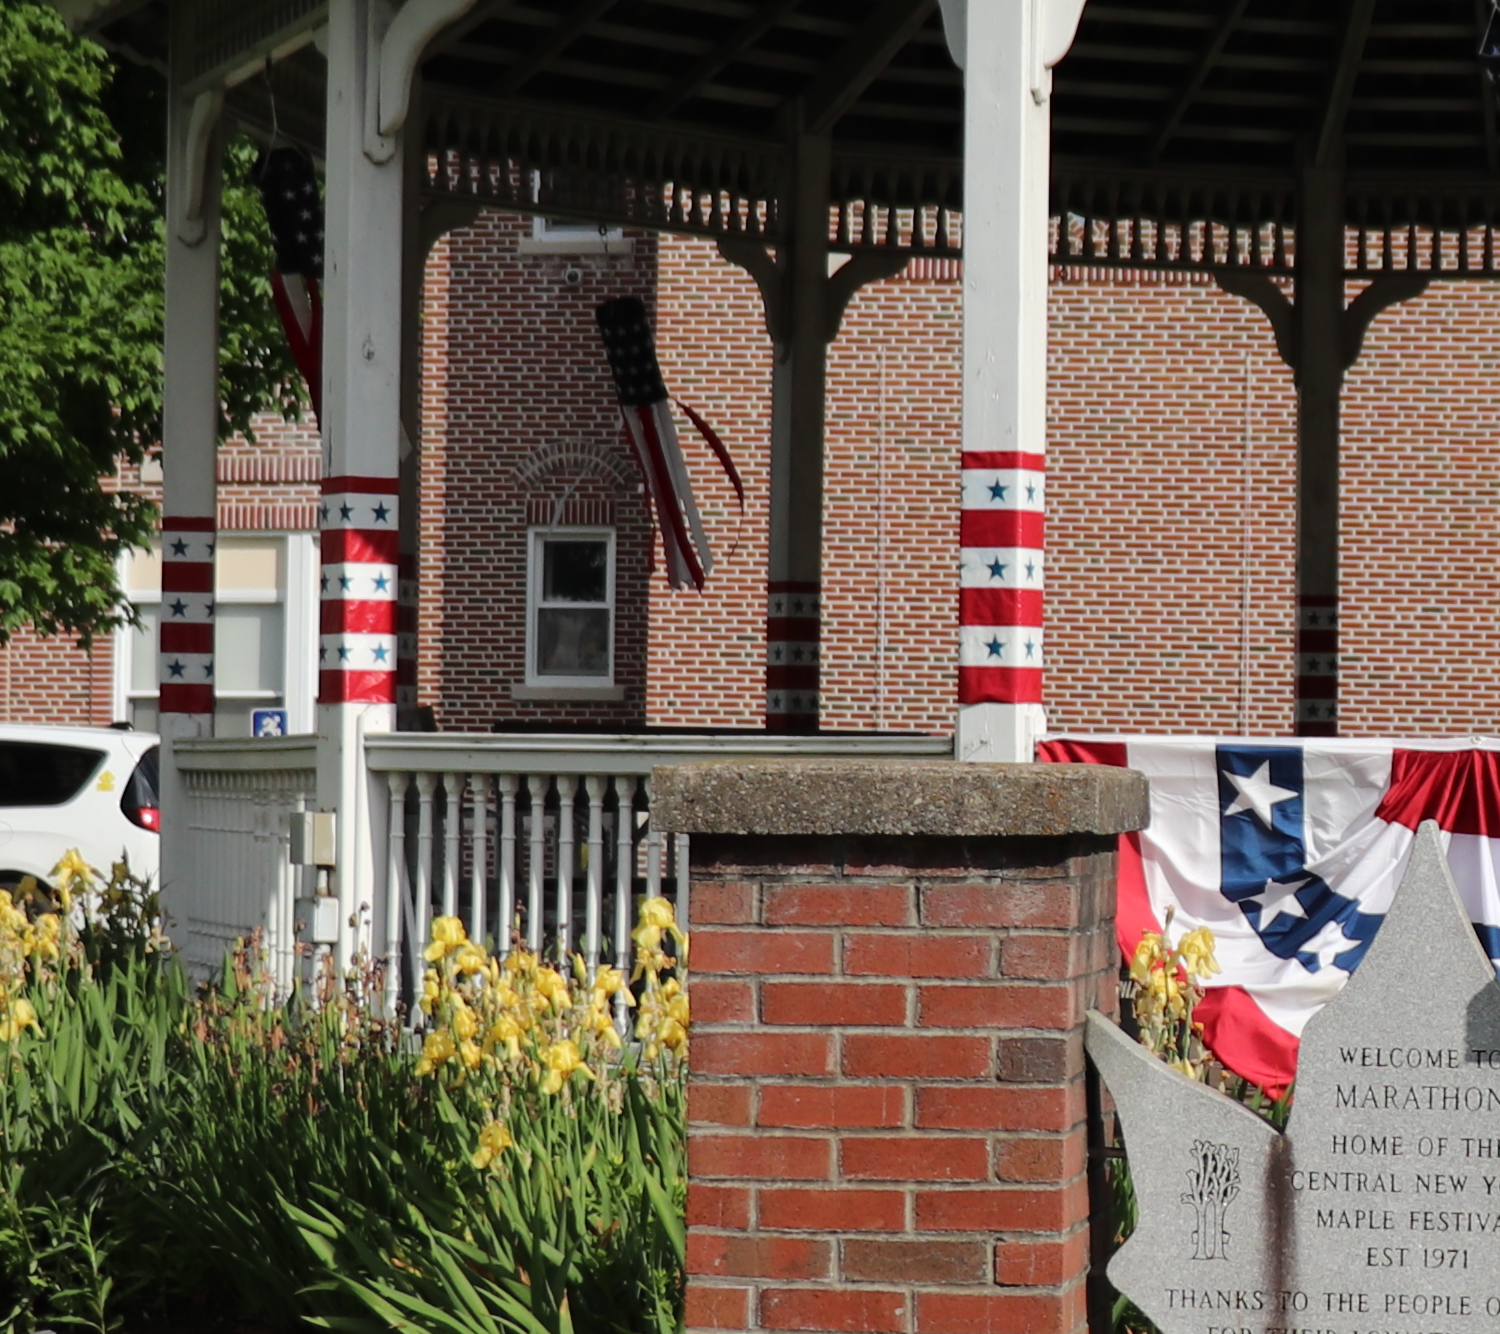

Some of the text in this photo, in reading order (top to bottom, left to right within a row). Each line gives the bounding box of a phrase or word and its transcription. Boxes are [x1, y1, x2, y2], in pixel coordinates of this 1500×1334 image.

[1339, 1047, 1460, 1068] WELCOME
[1331, 1134, 1404, 1156] HOME
[1418, 1136, 1449, 1157] OF
[1291, 1170, 1402, 1193] CENTRAL
[1415, 1174, 1468, 1195] NEW
[1316, 1209, 1395, 1230] MAPLE
[1366, 1247, 1470, 1270] EST 1971
[1165, 1288, 1264, 1311] THANKS
[1277, 1290, 1308, 1312] TO
[1323, 1292, 1370, 1313] THE
[1384, 1293, 1473, 1317] PEOPLE
